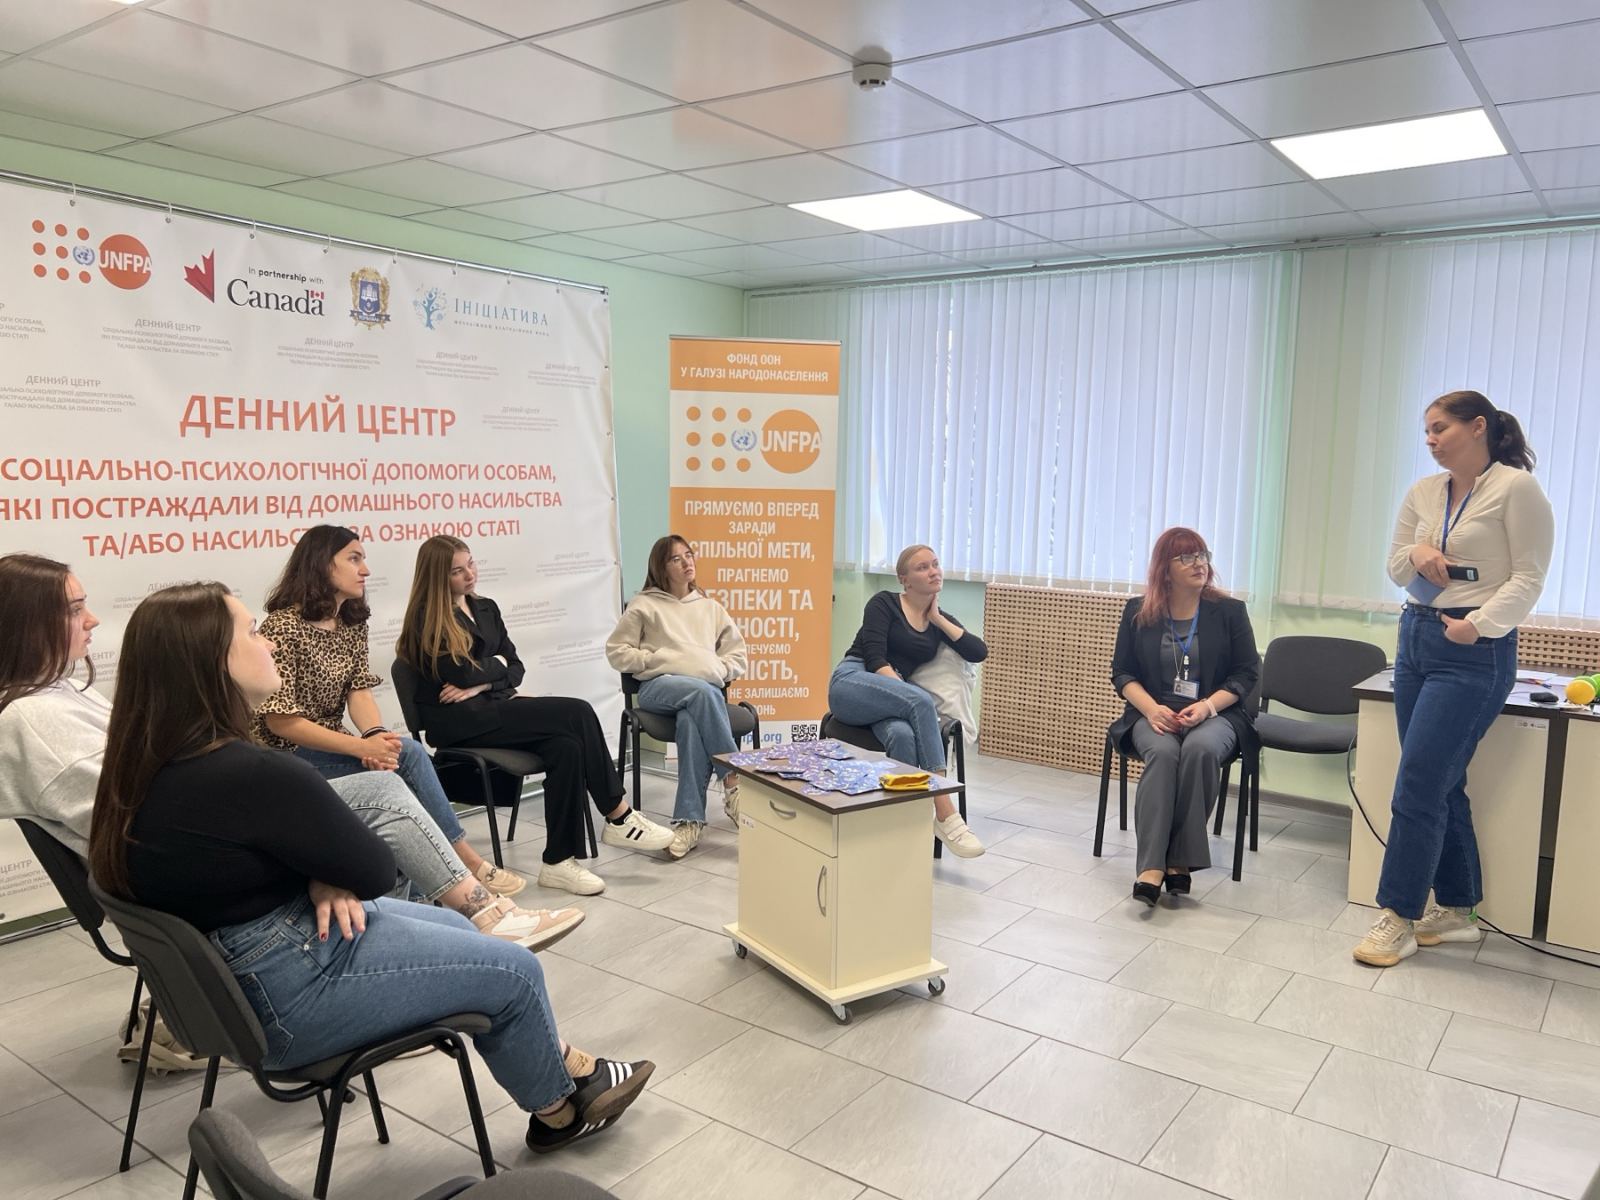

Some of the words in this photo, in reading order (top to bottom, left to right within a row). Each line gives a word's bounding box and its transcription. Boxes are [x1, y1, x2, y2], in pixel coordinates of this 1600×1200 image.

[258, 269, 307, 284] partnership
[308, 276, 324, 284] with
[227, 278, 325, 317] Canada
[455, 298, 548, 326] ІНІЦІАТИВА
[135, 318, 174, 330] ДЕННИЙ
[175, 322, 202, 333] ЦЕНТР
[727, 353, 758, 366] ФОНД
[760, 354, 781, 365] ООН
[26, 375, 69, 386] ДЕННИЙ
[70, 378, 102, 388] ЦЕНТР
[680, 367, 688, 377] У
[690, 367, 726, 379] ГАЛУЗІ
[729, 369, 828, 382] НАРОДОНАСЕЛЕННЯ
[180, 394, 346, 438] ДЕННИЙ
[357, 404, 456, 442] ЦЕНТР
[760, 430, 822, 453] UNFPA
[1, 458, 368, 486] СОЦІАЛЬНО-ПСИХОЛОГІЧНОЇ
[372, 462, 479, 485] ДОПОМОГИ
[484, 464, 556, 484] ОСОБАМ,
[52, 496, 258, 522] ПОСТРАЖДАЛИ
[265, 495, 303, 519] ВІД
[308, 492, 454, 518] ДОМАШНЬОГО
[459, 492, 562, 510] НАСИЛЬСТВА
[685, 500, 764, 517] ПРЯМУЄМО
[767, 502, 819, 520] ВПЕРЕД
[83, 532, 185, 559] ТА/АБО
[192, 528, 309, 552] НАСИЛЬС
[379, 521, 473, 541] ОЗНАКОЮ
[477, 519, 520, 537] СТАТІ
[729, 522, 776, 536] ЗАРАДИ
[767, 542, 815, 562] МЕТИ,
[717, 568, 789, 583] ПРАГНЕМО
[788, 589, 814, 610] ТА
[729, 688, 742, 699] НЕ
[744, 687, 809, 699] ЗАЛИШАЄМО
[0, 859, 32, 874] ЦЕНТР
